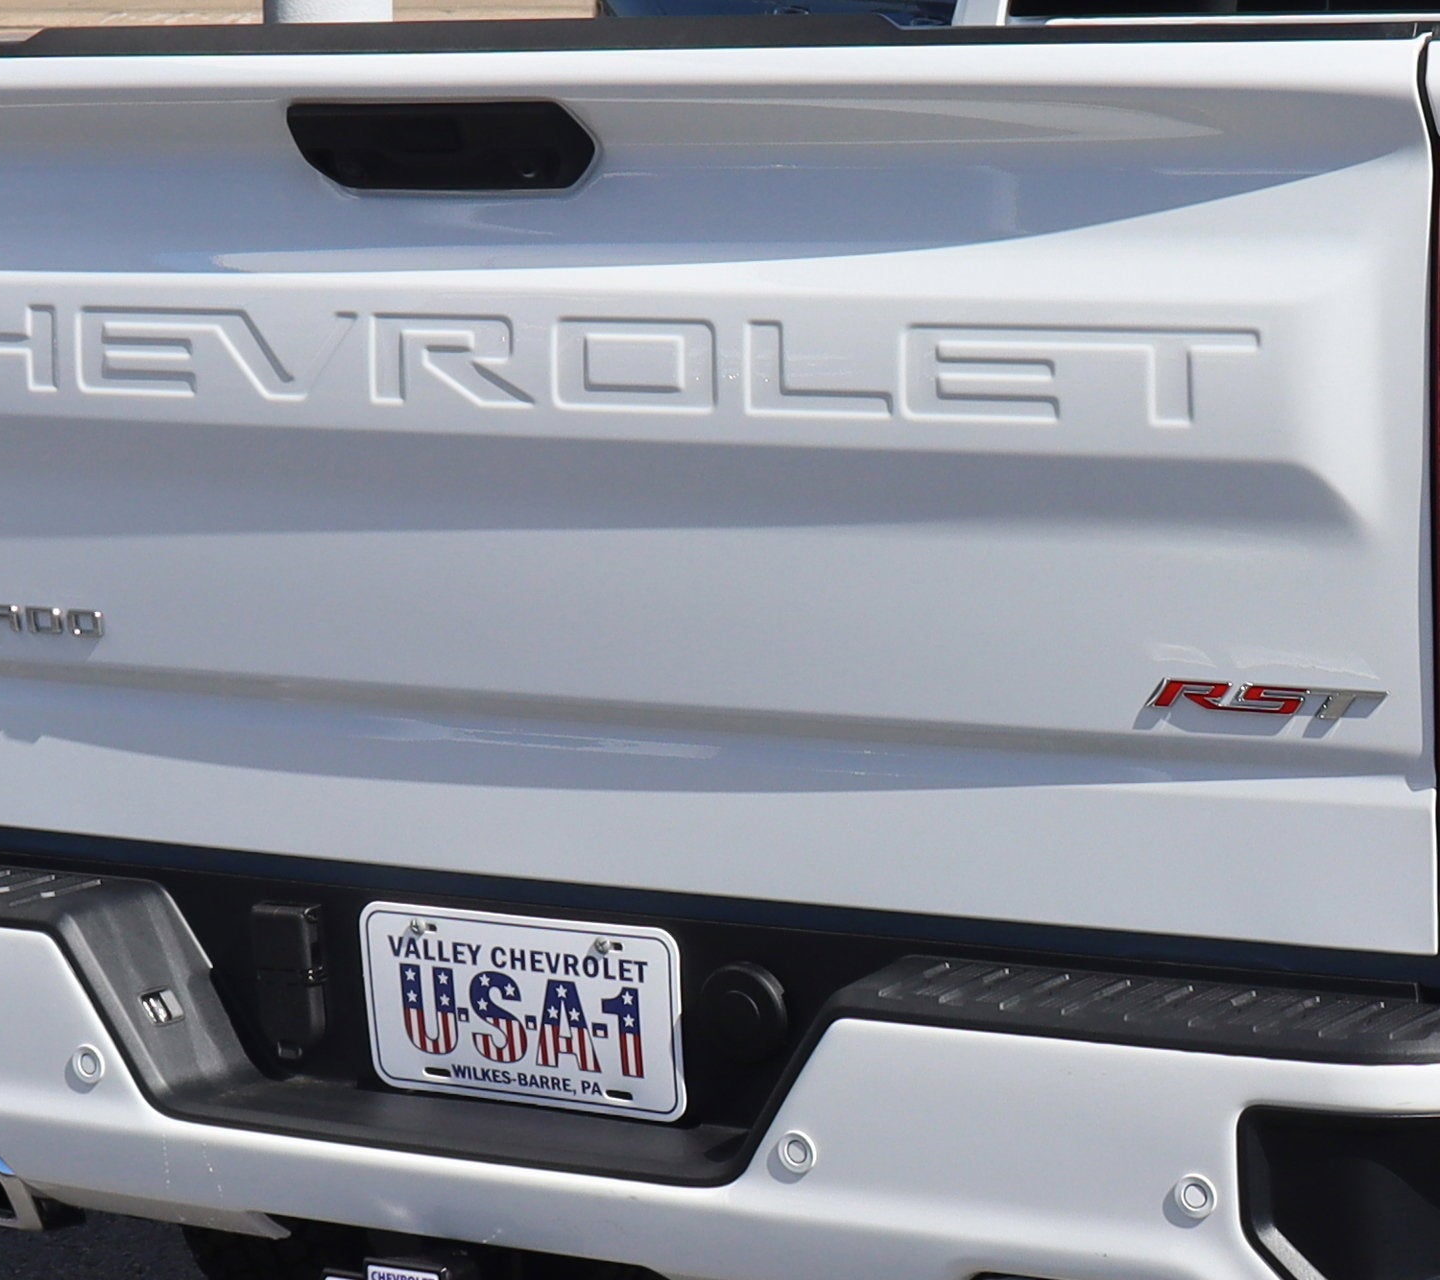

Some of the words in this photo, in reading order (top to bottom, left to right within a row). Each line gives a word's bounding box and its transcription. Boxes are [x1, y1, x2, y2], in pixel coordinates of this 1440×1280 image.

[1145, 676, 1392, 720] RST
[387, 935, 482, 966] VALLEY
[491, 946, 648, 984] CHEVROLET
[451, 1063, 577, 1096] WILKES-BARRE,
[581, 1080, 602, 1096] PA
